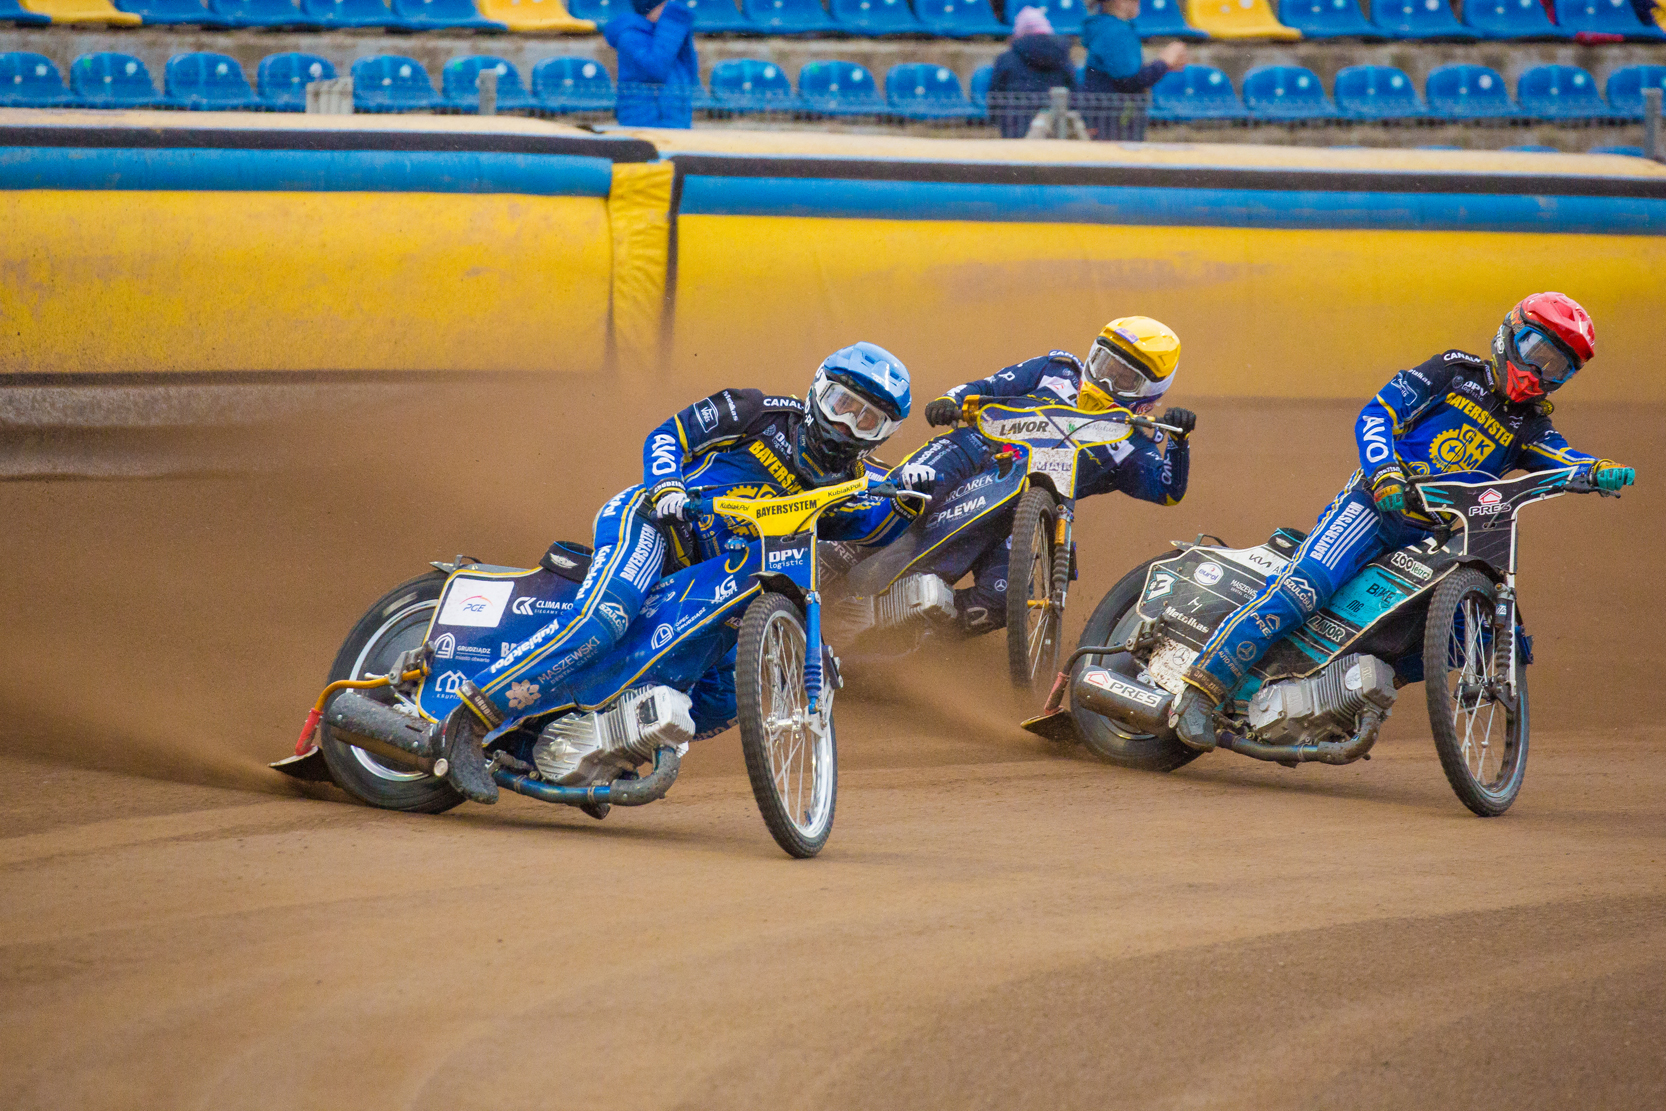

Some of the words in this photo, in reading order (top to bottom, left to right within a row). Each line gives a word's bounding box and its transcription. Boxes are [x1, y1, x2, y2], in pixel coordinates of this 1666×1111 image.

[1000, 421, 1049, 436] LAVOR
[1362, 415, 1389, 463] AVO
[651, 434, 677, 476] AVO
[828, 483, 862, 498] KubiakPol
[720, 502, 750, 511] KubiakPol
[756, 499, 818, 519] BAYERSYSTEM
[938, 496, 987, 522] PLEWA
[1469, 502, 1512, 516] PRES
[1310, 501, 1365, 561] BAYERSYSTEM
[620, 523, 657, 582] BAYERSYSTEM
[769, 548, 806, 563] DPV
[769, 559, 804, 569] logistic
[1198, 568, 1220, 582] eurol
[463, 604, 486, 612] PGE
[536, 600, 560, 609] CLIMA
[1164, 606, 1209, 634] Metalkas
[538, 635, 601, 683] MASZEWSKI
[1109, 682, 1160, 706] PRES
